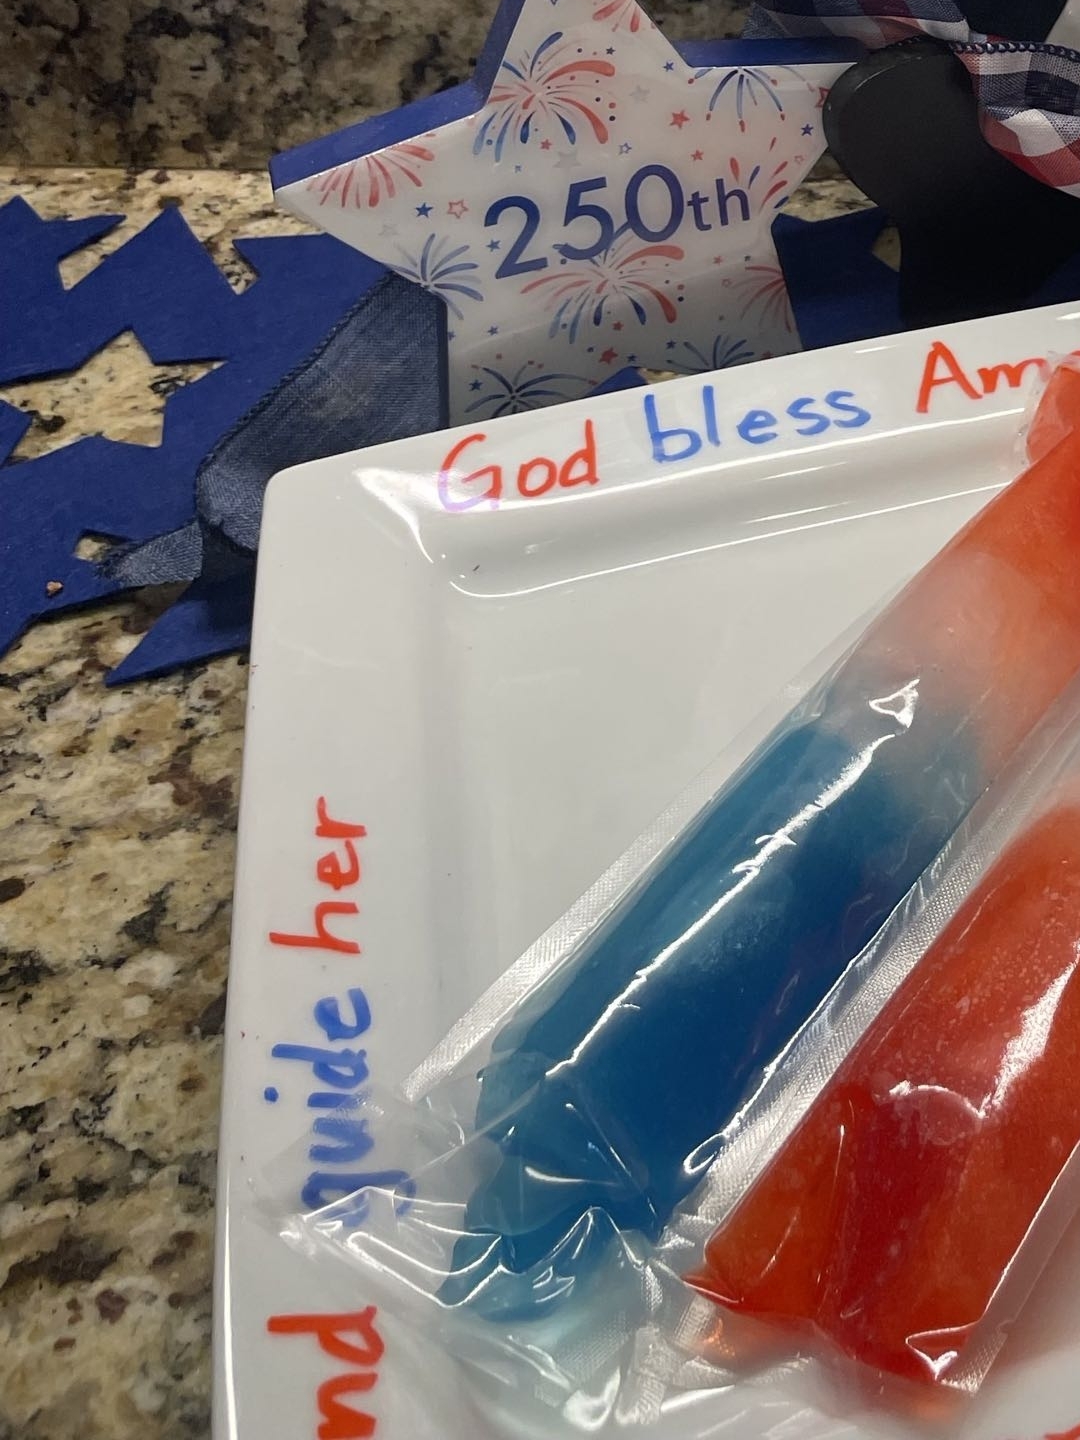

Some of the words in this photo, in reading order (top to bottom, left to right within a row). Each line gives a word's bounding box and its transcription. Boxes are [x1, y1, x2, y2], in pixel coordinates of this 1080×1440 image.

[483, 164, 752, 280] 250th
[437, 419, 600, 515] God
[644, 385, 872, 464] bless
[268, 795, 367, 954] her
[263, 987, 417, 1229] guide
[266, 1305, 386, 1440] nd
